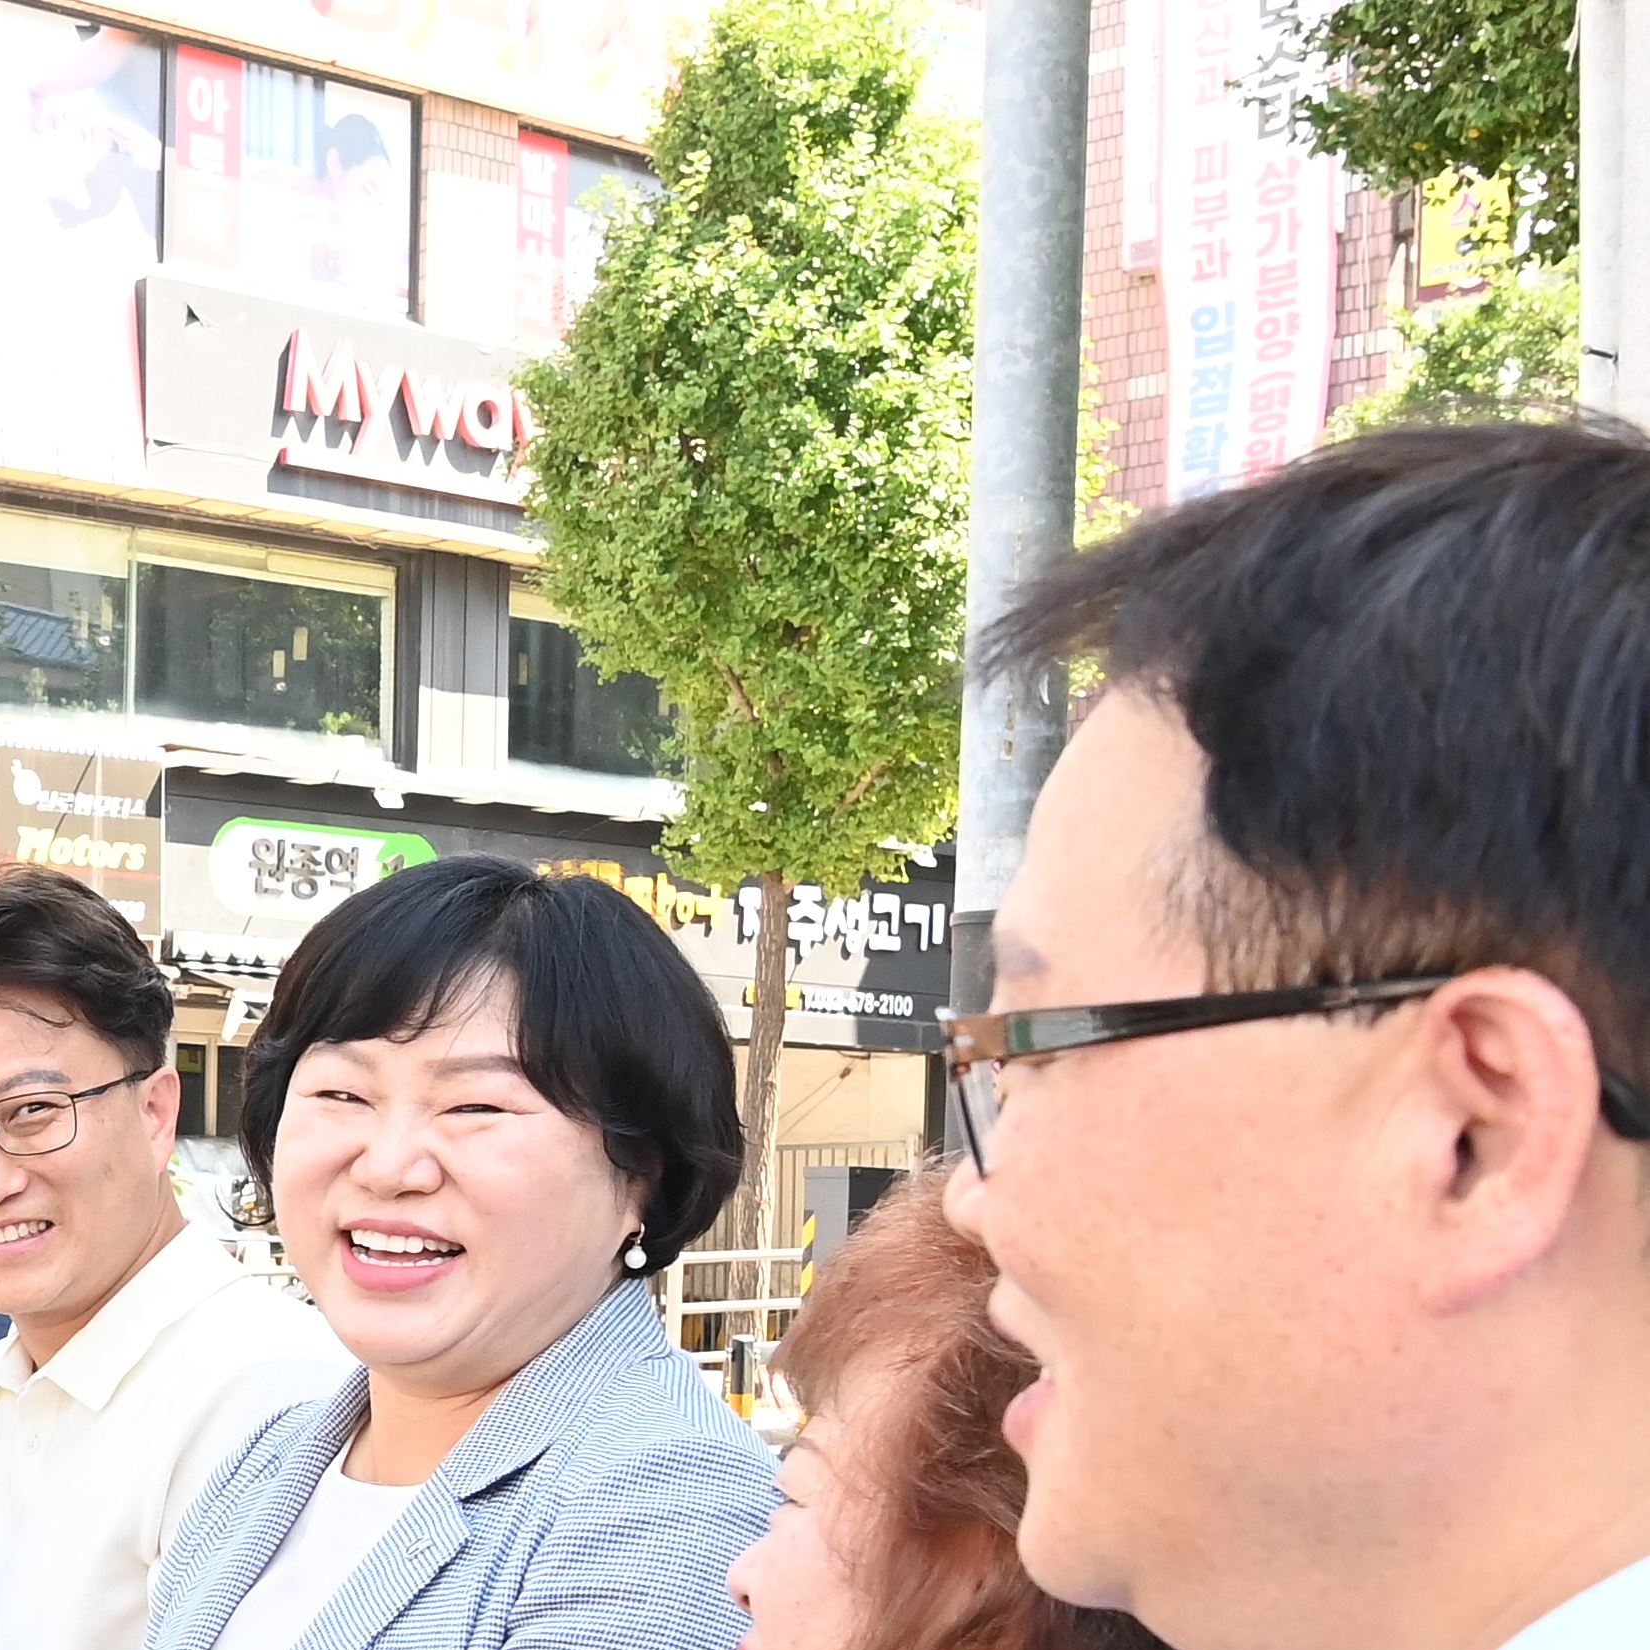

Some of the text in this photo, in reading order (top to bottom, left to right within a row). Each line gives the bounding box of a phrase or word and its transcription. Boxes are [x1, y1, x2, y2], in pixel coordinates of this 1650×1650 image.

[1255, 155, 1302, 363] 상가분양
[1182, 300, 1236, 498] 입점확
[17, 826, 146, 871] Motors
[249, 838, 360, 899] 원종역
